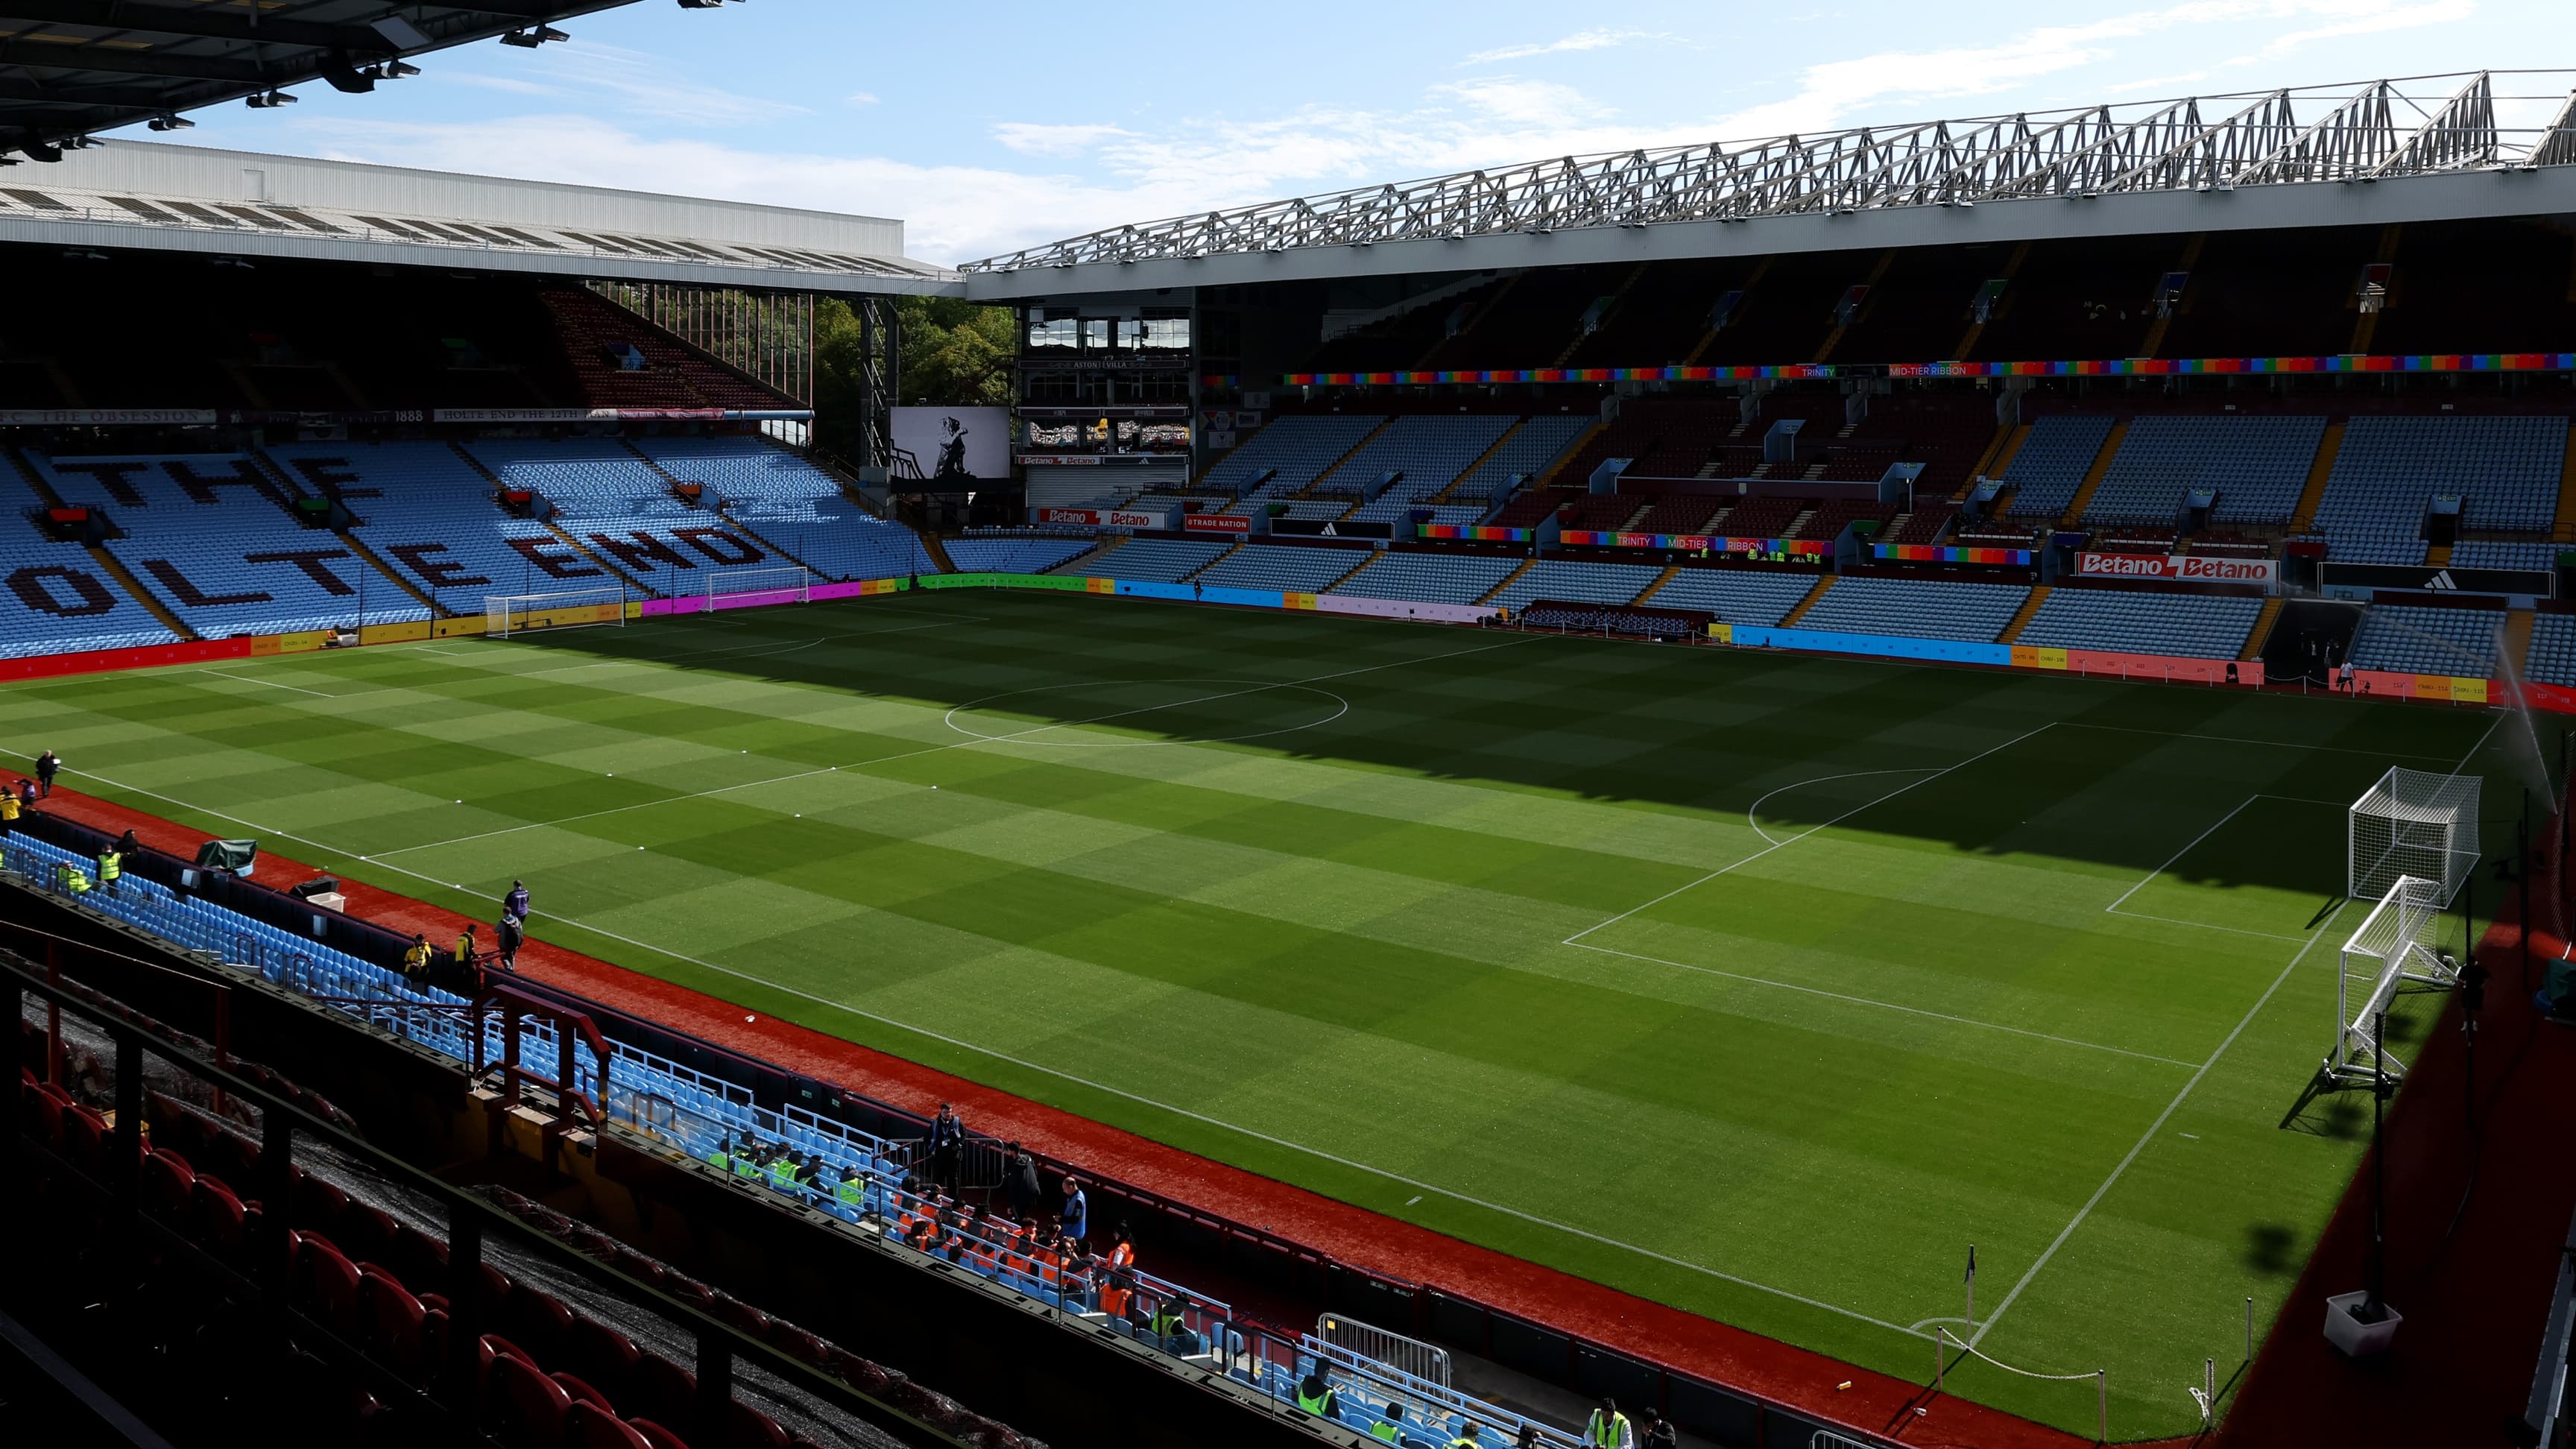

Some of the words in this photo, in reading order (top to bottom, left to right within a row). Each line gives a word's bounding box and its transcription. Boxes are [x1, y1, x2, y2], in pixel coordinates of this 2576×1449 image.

[1073, 361, 1097, 369] ASTON
[1106, 361, 1126, 369] VILLA
[1802, 368, 1834, 376] TRINITY
[1890, 367, 1929, 376] MID-TIER
[1931, 366, 1966, 376] RIBBON
[42, 411, 81, 422] THE
[91, 411, 198, 422] OBSESSION
[396, 409, 424, 423] 1888
[443, 411, 484, 420] HOLTE
[491, 411, 515, 420] END
[523, 410, 545, 419] THE
[552, 409, 578, 419] 12TH
[1067, 456, 1096, 464] Betano
[1049, 510, 1086, 525] Betano
[1111, 512, 1149, 526] Betano
[1192, 517, 1216, 527] TRADE
[1219, 519, 1247, 528] NATION
[1617, 536, 1650, 547] TRINITY
[1668, 538, 1708, 550] MID-TIER
[1728, 541, 1764, 552] RIBBON
[504, 527, 766, 579] END
[2083, 555, 2162, 575] Betano
[2182, 558, 2267, 580] Betano
